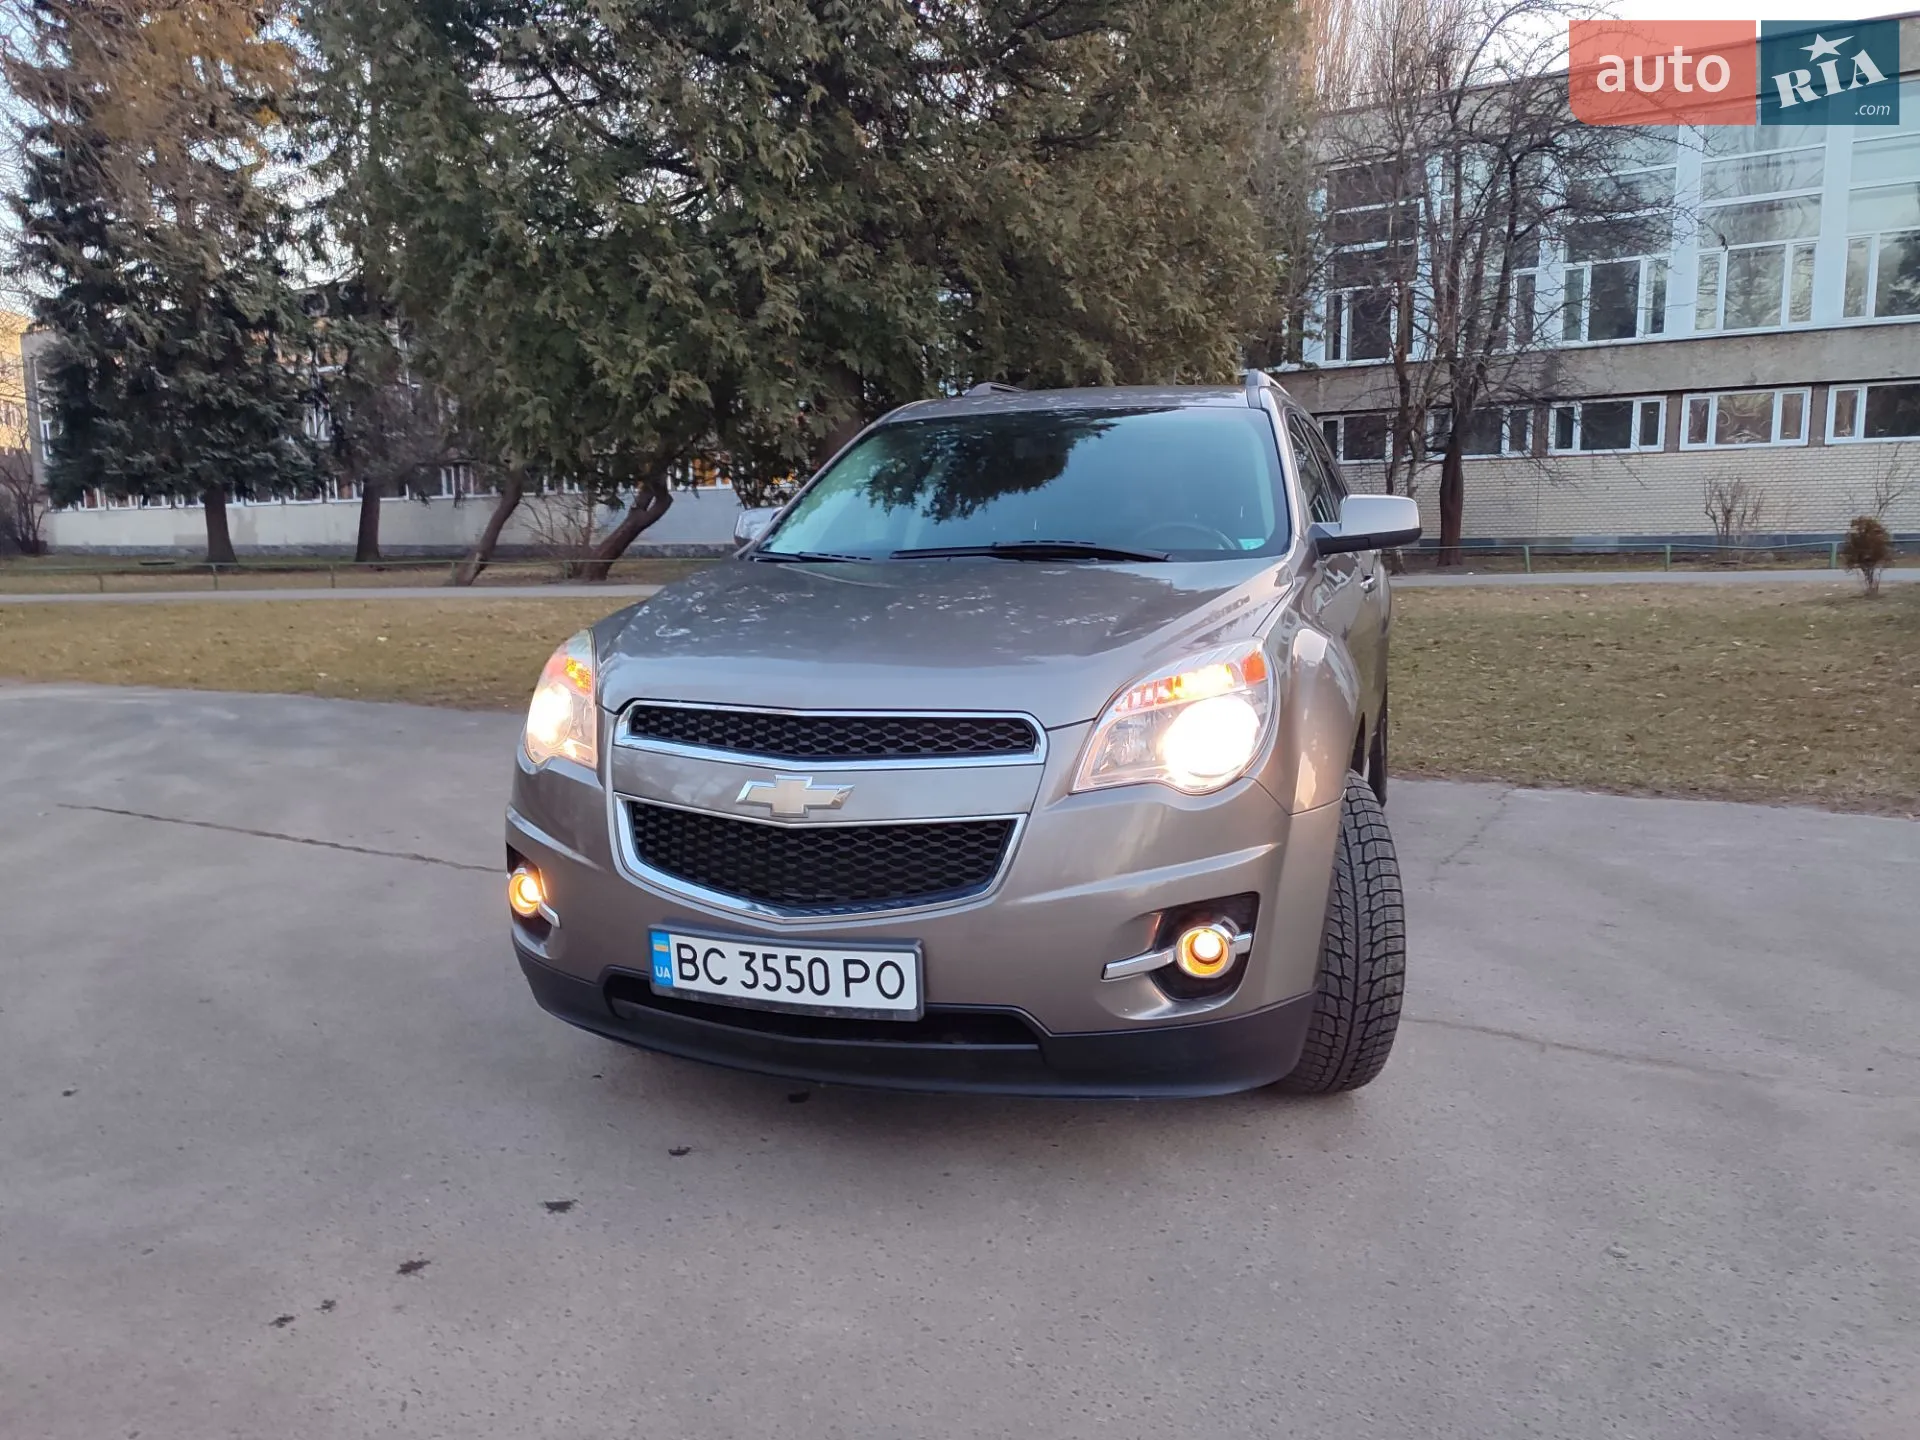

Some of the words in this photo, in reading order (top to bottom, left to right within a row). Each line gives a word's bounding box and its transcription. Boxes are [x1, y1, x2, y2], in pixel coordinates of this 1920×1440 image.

[655, 965, 671, 980] UA
[676, 943, 728, 985] BC
[738, 951, 830, 996] 3550
[843, 959, 905, 1000] PO
